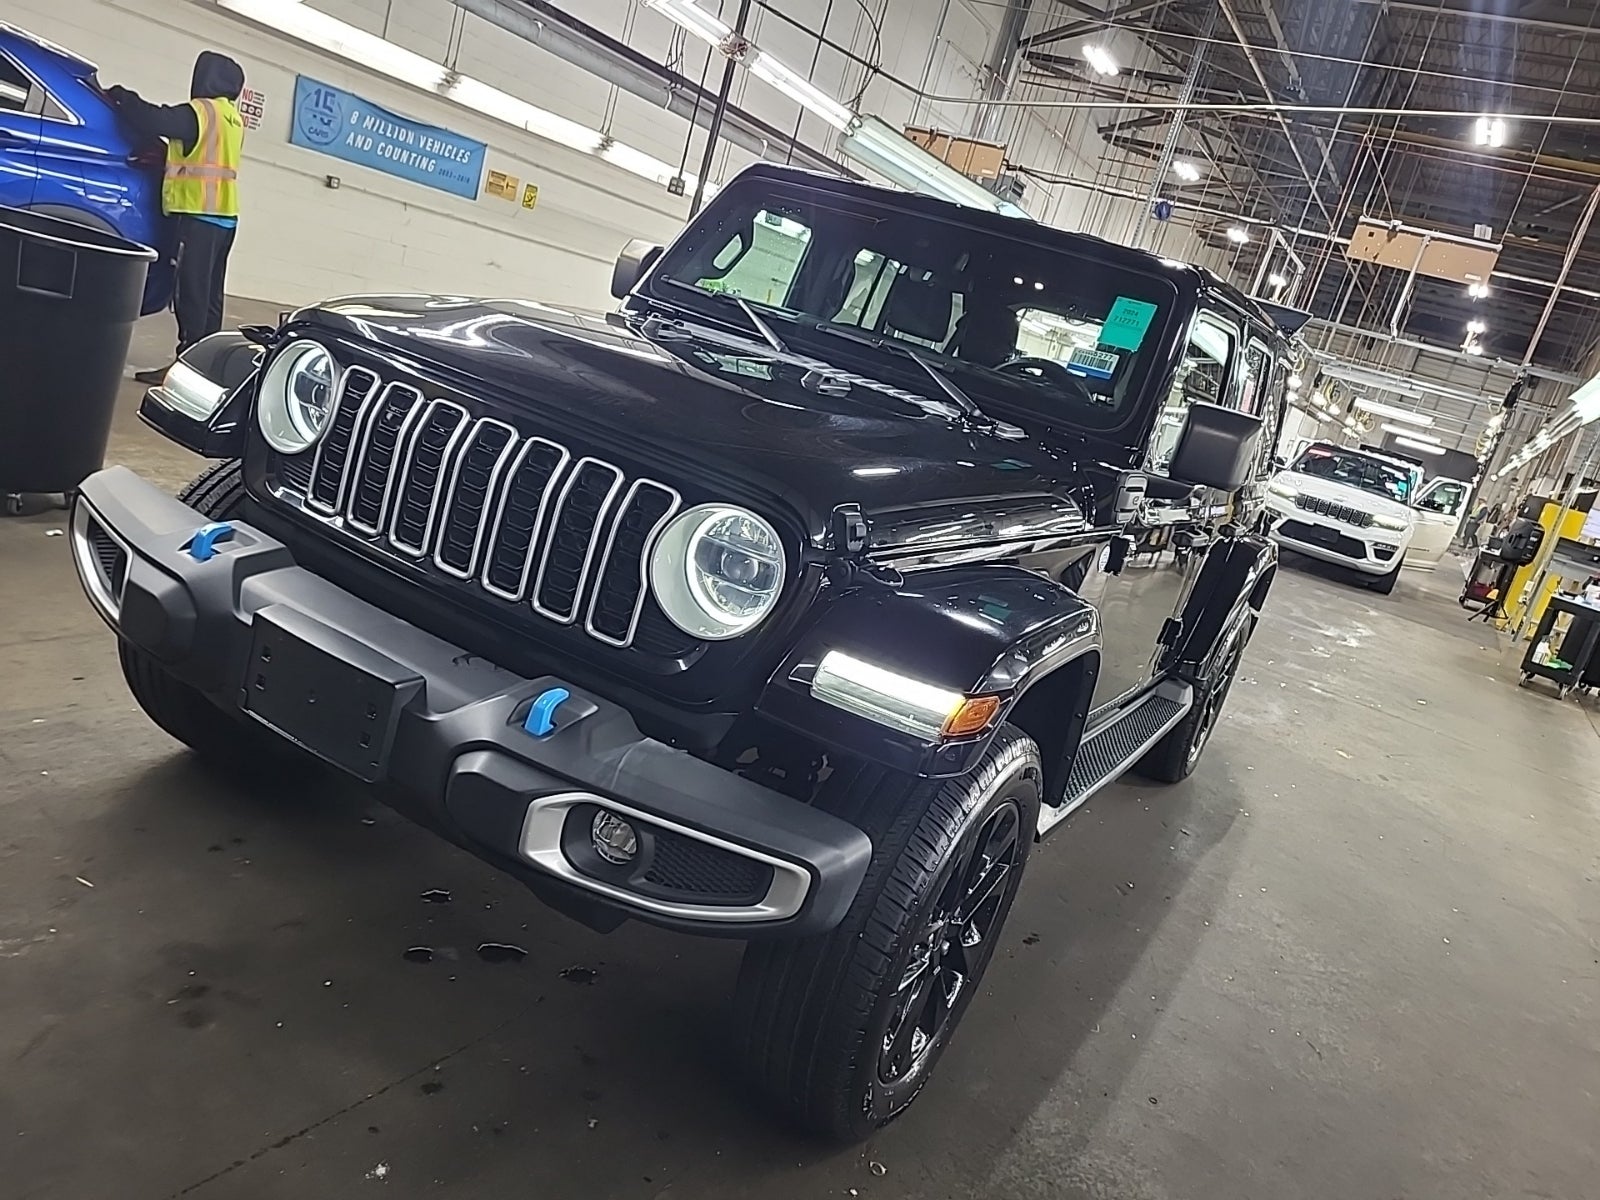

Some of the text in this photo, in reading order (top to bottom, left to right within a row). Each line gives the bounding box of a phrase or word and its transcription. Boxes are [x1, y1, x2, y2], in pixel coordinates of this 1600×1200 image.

[346, 131, 437, 172] AND COUNTING
[350, 110, 360, 125] 8
[363, 115, 415, 145] MILLION
[420, 135, 471, 164] VEHICLES
